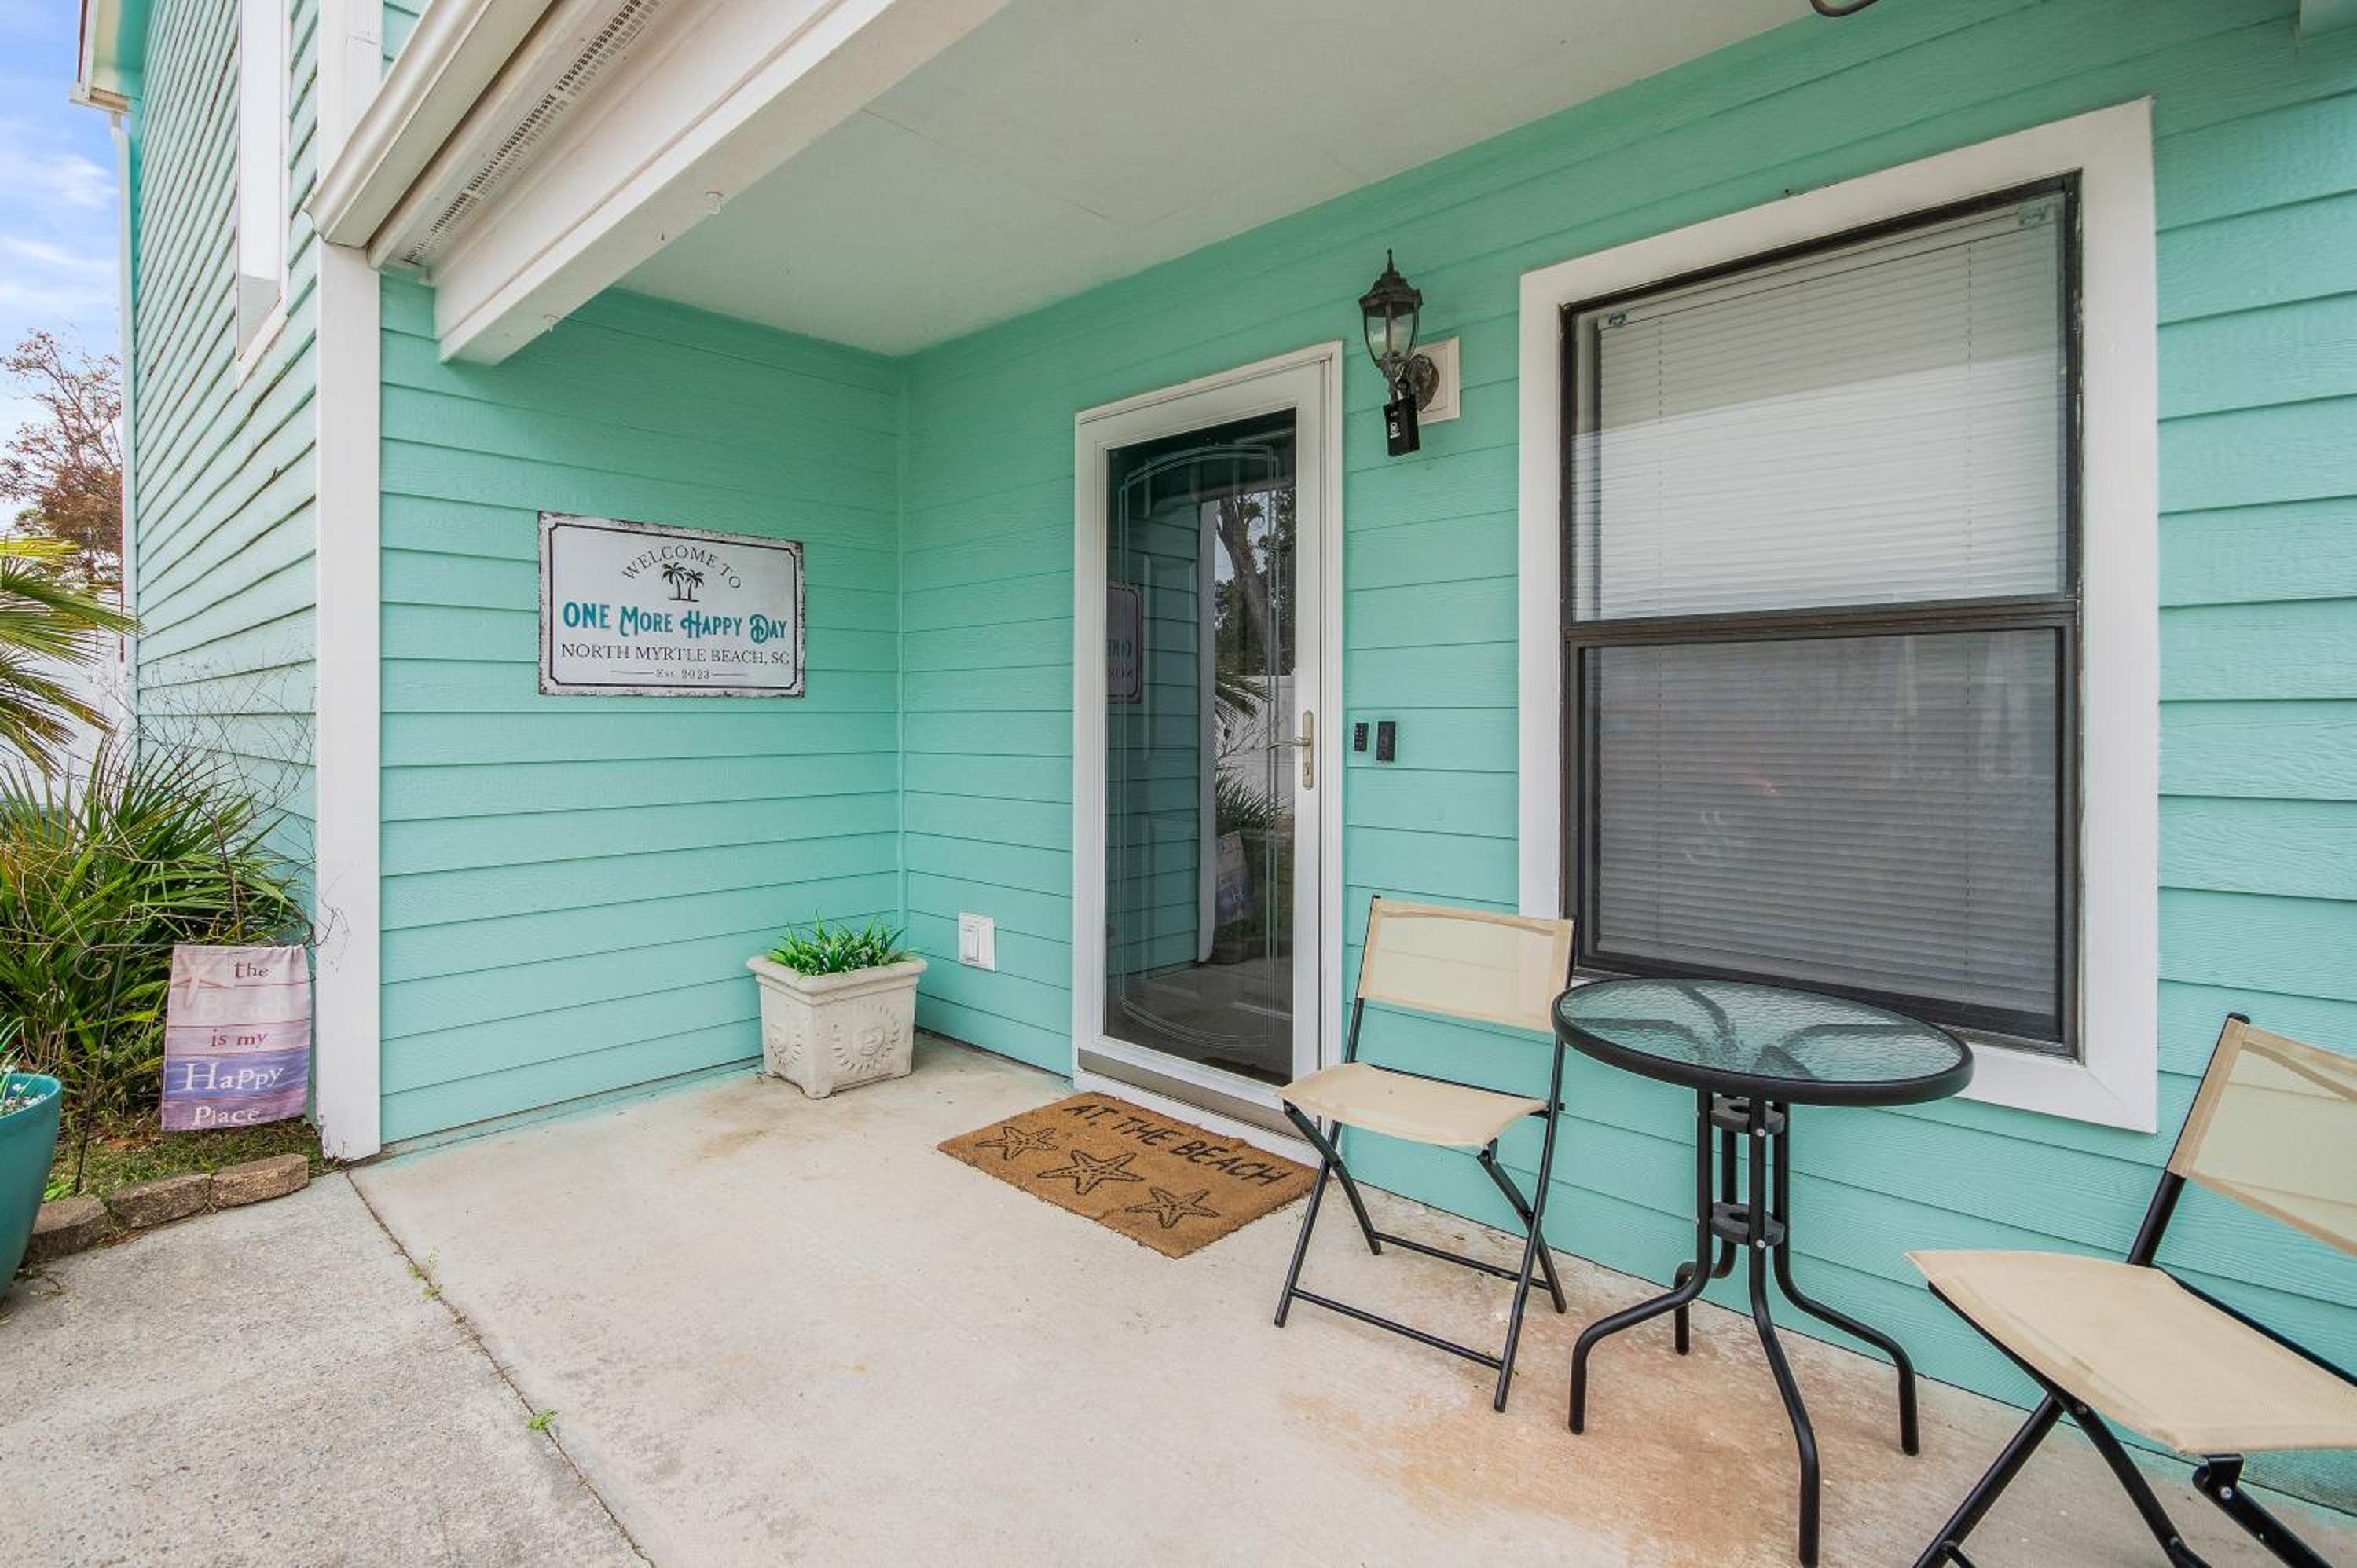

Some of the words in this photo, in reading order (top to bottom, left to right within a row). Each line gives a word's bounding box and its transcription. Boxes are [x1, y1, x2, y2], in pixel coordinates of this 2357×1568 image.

[621, 544, 719, 581] WELCOME
[721, 562, 742, 589] TO
[563, 601, 611, 629] ONE
[561, 643, 629, 660] NORTH
[636, 647, 706, 662] MYRTLE
[711, 649, 768, 665] BEACH,
[771, 651, 790, 665] SC
[681, 669, 710, 680] 2023
[234, 962, 269, 979] the
[210, 1028, 227, 1046] is
[236, 1032, 267, 1048] my
[192, 1105, 262, 1127] Place
[1064, 1104, 1120, 1126] AT
[1111, 1116, 1182, 1148] THE
[1168, 1139, 1293, 1187] BEACH
